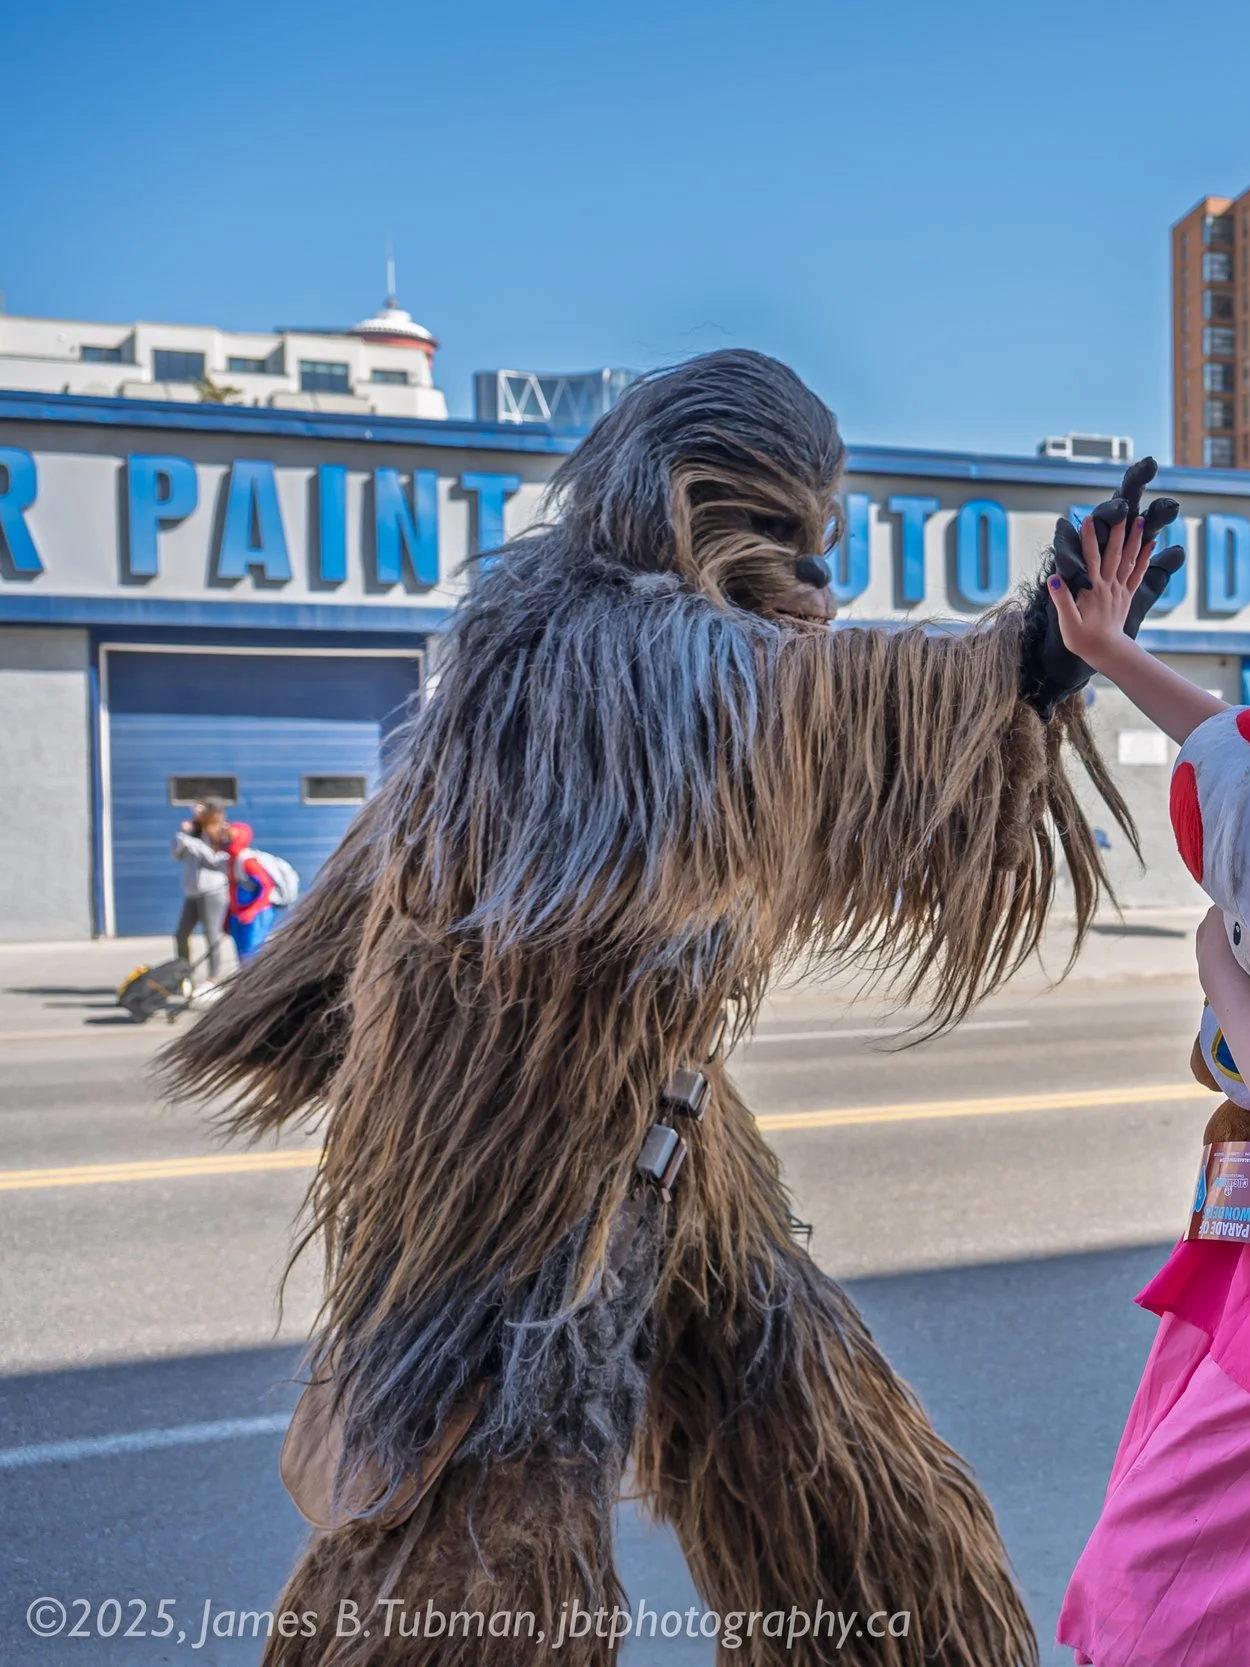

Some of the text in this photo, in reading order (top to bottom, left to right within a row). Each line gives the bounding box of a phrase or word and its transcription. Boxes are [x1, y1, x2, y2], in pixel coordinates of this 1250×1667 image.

[128, 453, 521, 585] PAINT
[1200, 1220, 1250, 1237] PARADE OF
